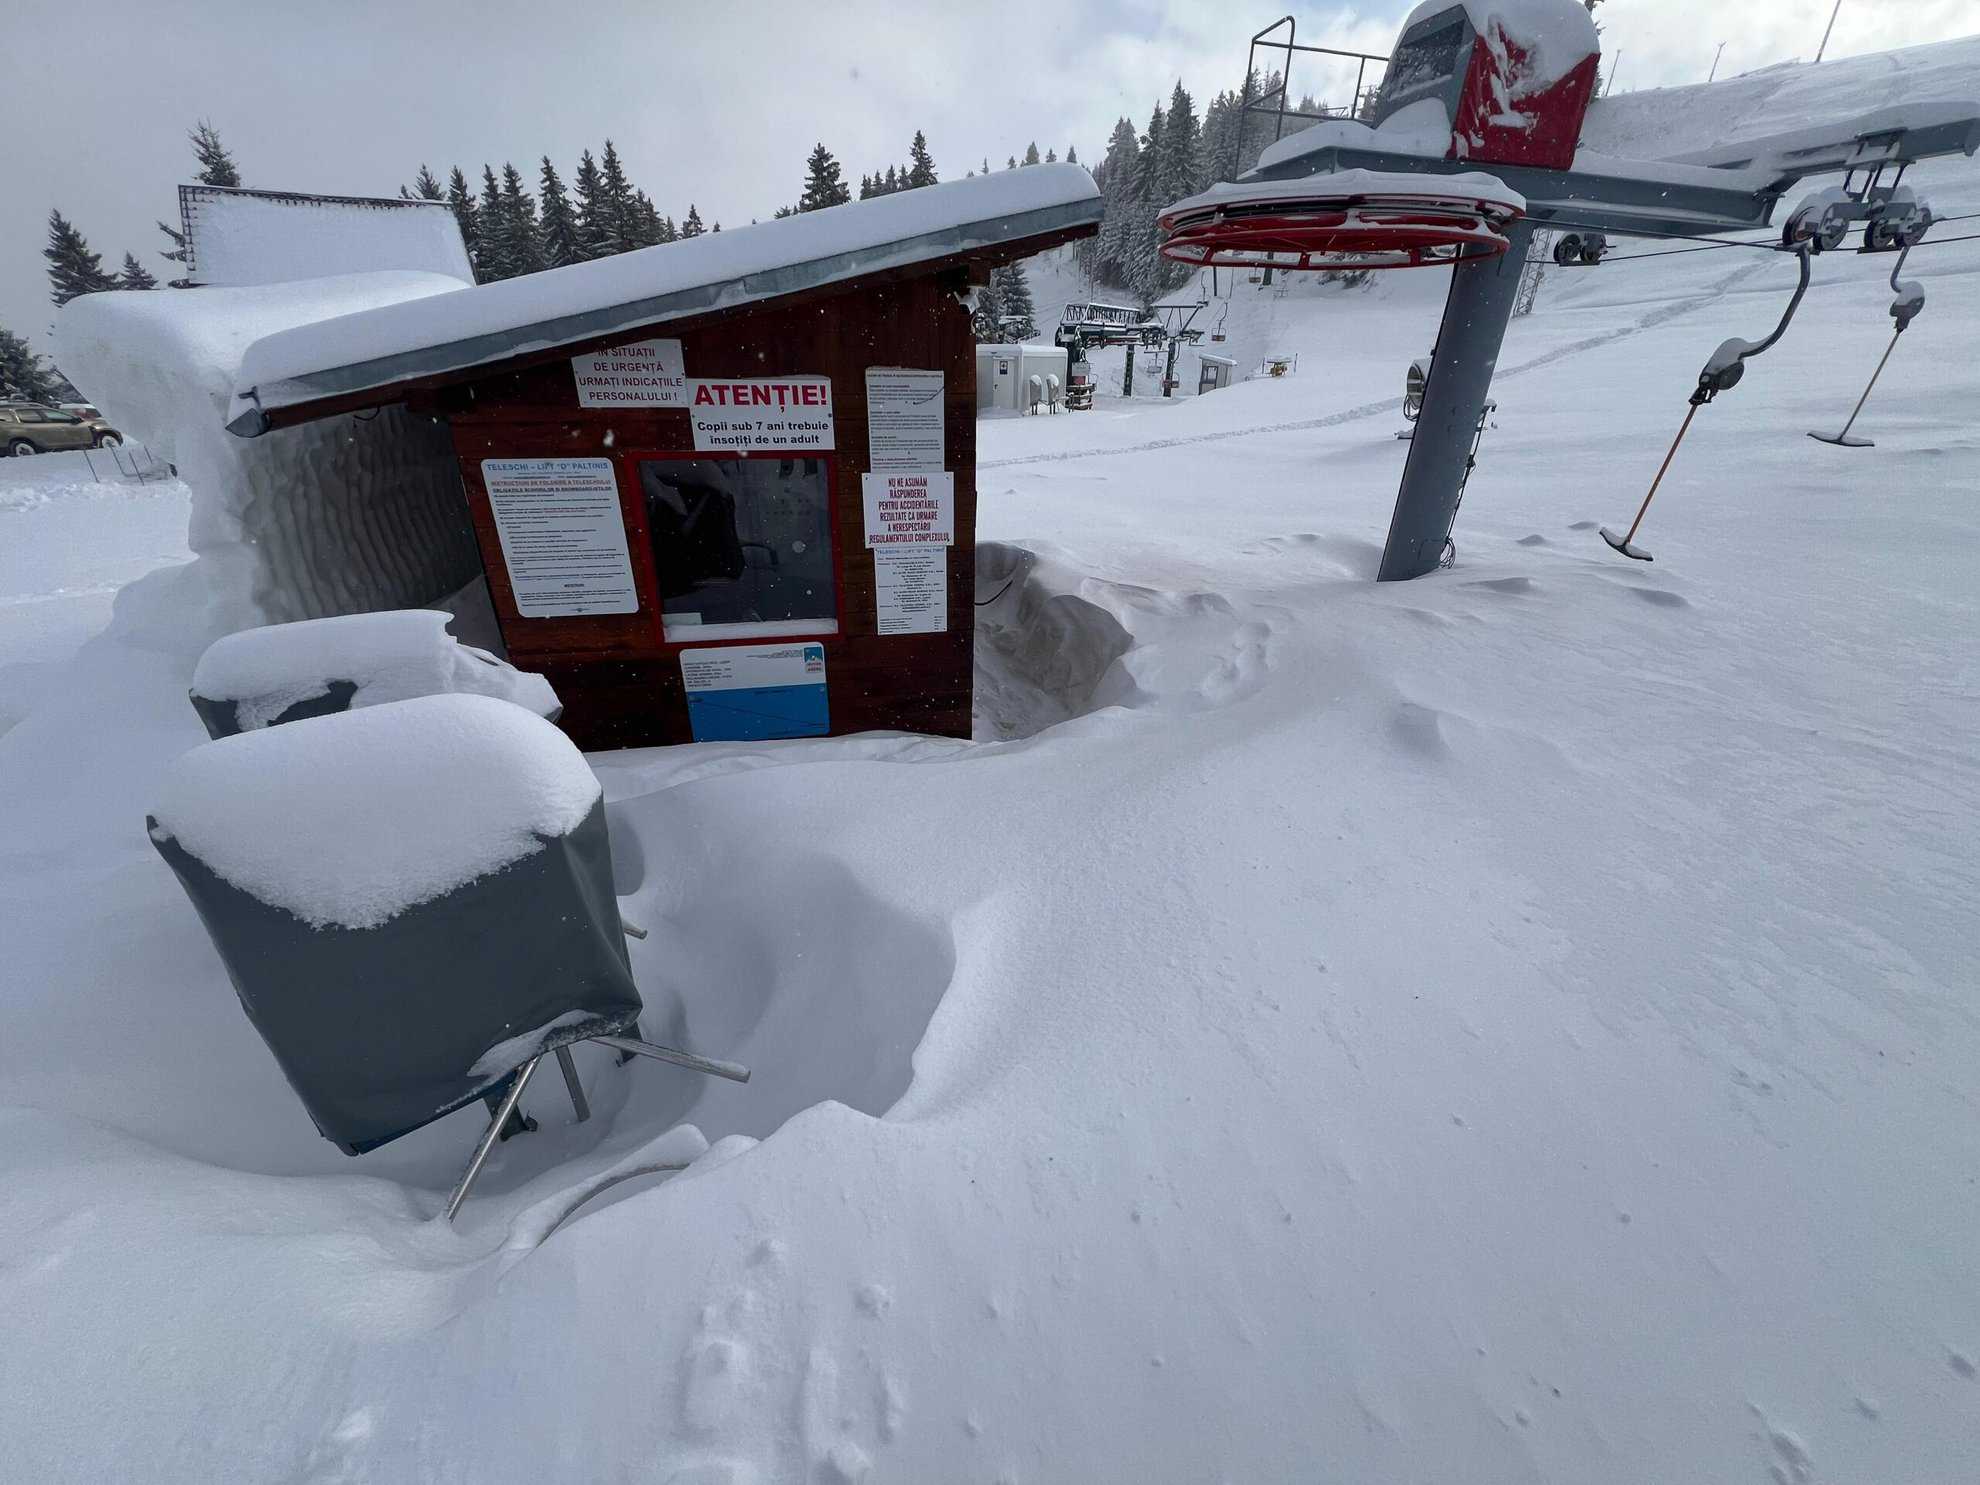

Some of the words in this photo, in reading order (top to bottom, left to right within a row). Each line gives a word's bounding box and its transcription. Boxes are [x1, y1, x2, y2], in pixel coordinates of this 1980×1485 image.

[593, 361, 608, 371] DE
[589, 391, 671, 401] PERSONALULUI
[694, 384, 827, 413] ATENȚIE!
[697, 421, 728, 433] Copii
[732, 421, 752, 431] sub
[756, 421, 763, 430] 7
[767, 421, 785, 430] ani
[788, 421, 829, 431] trebuie
[709, 434, 752, 447] însoțiți
[755, 435, 769, 444] de
[773, 436, 787, 444] un
[791, 434, 820, 444] adult
[888, 477, 896, 487] NU
[897, 477, 904, 487] NE
[878, 500, 899, 511] PENTRU
[880, 511, 907, 521] REZULTATE
[907, 511, 915, 520] CA
[916, 511, 938, 520] URMARE
[888, 523, 892, 532] A
[870, 533, 914, 543] REGULAMENTULUI
[915, 532, 949, 542] COMPLEXULUI
